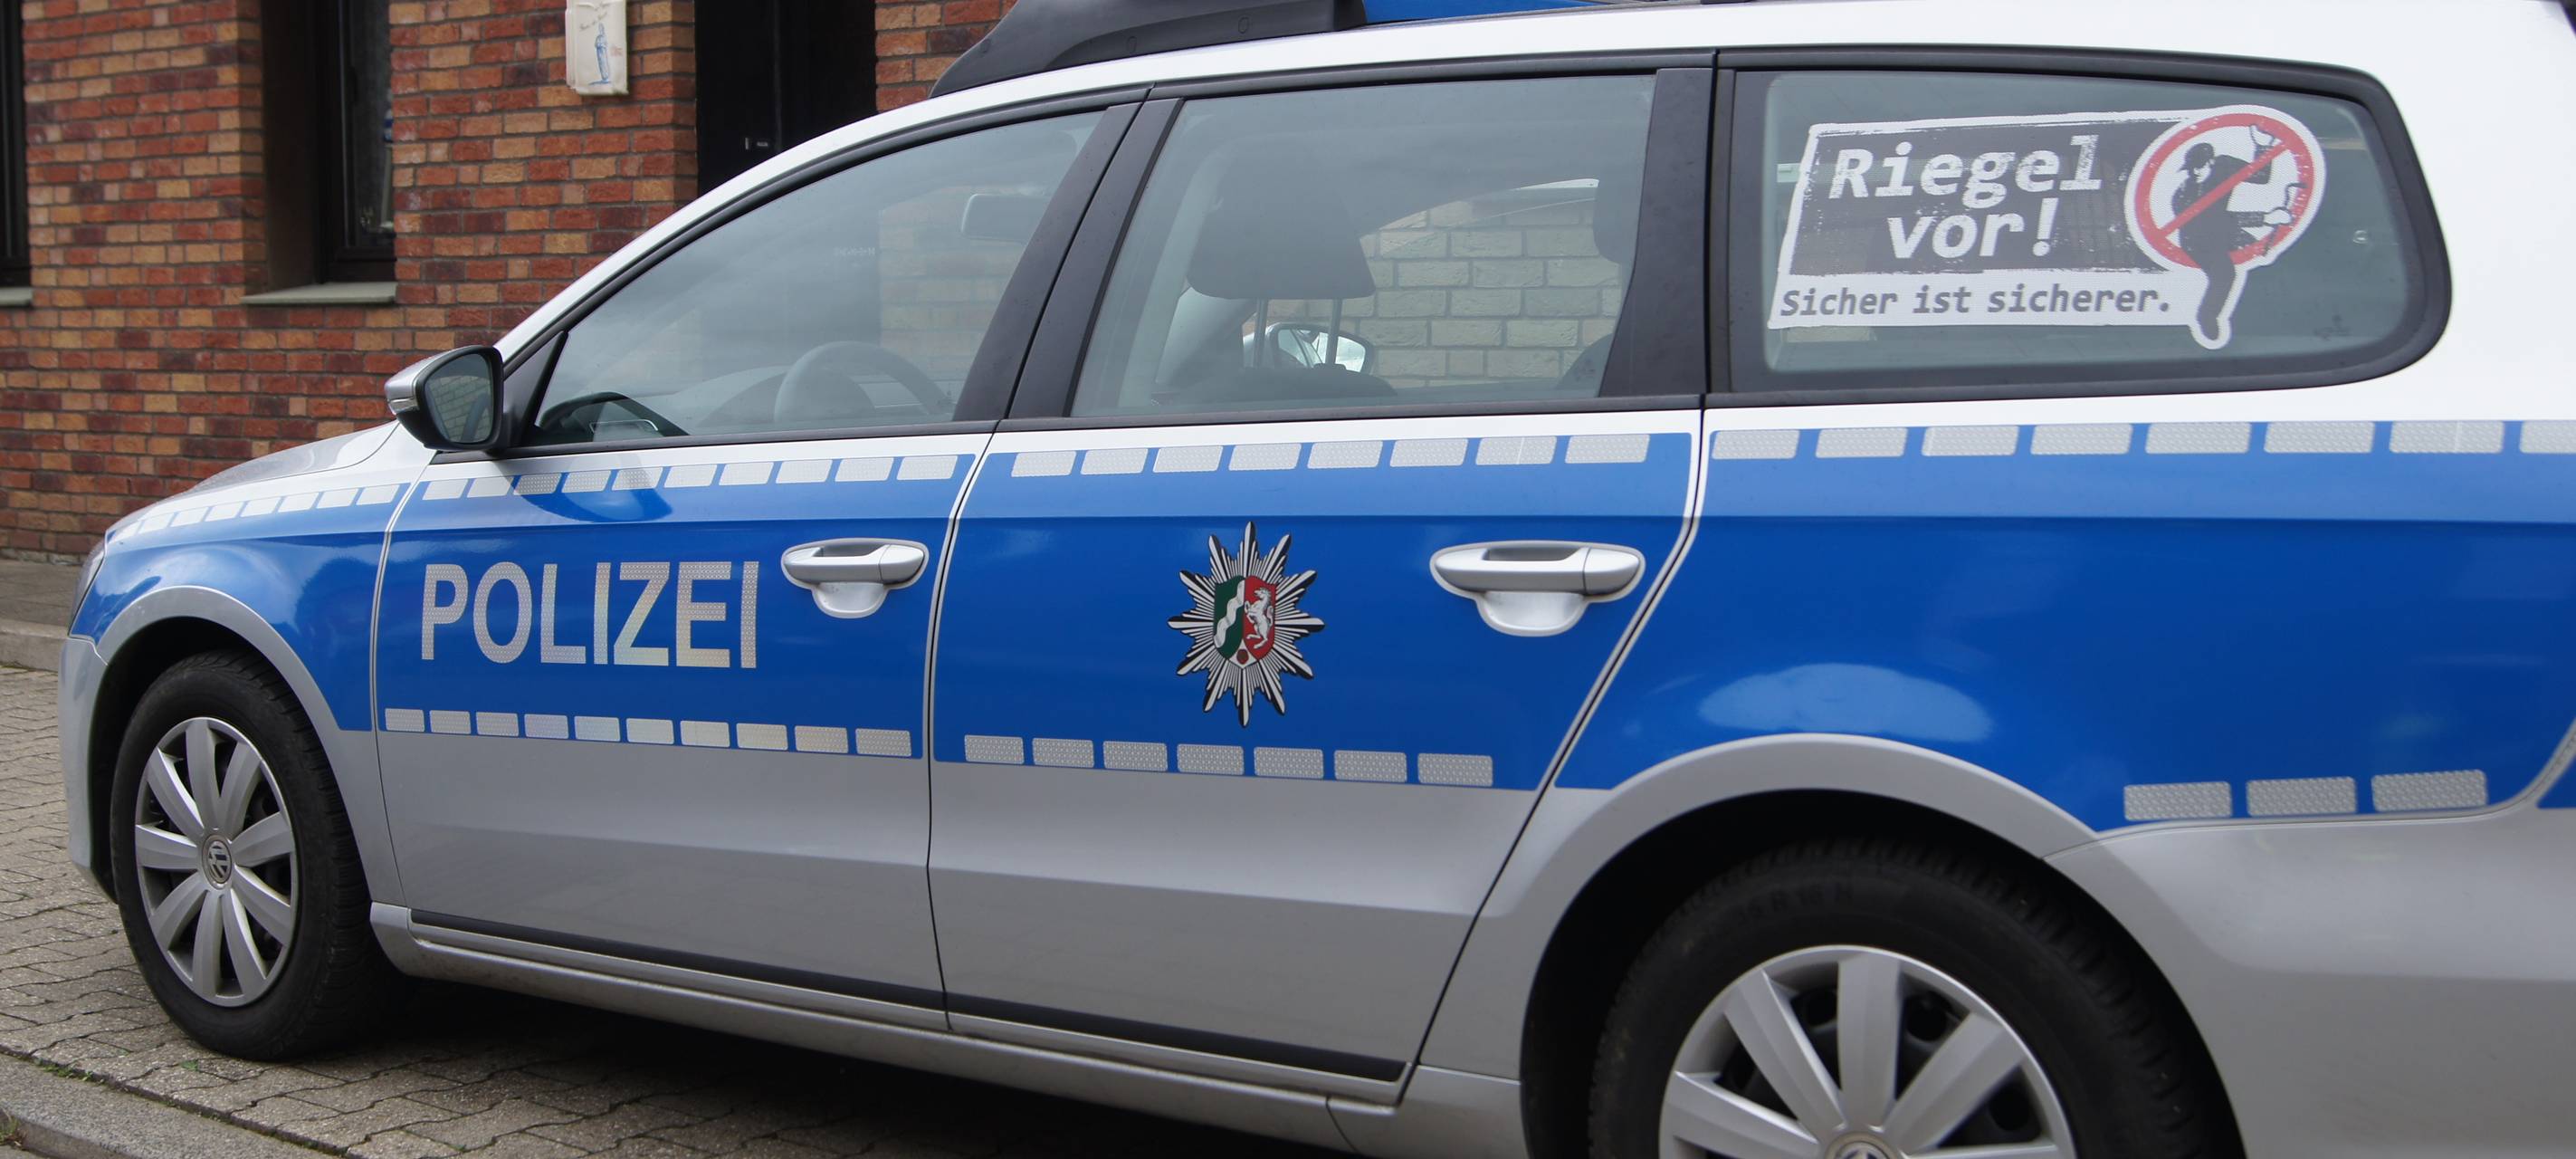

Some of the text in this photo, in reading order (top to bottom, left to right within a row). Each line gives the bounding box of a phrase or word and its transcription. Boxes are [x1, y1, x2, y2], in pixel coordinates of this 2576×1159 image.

[1828, 134, 2103, 209] Riegel
[1886, 196, 2059, 259] vor!
[1780, 283, 2171, 316] Sicher ist sicherer.
[421, 560, 759, 669] POLIZEI
